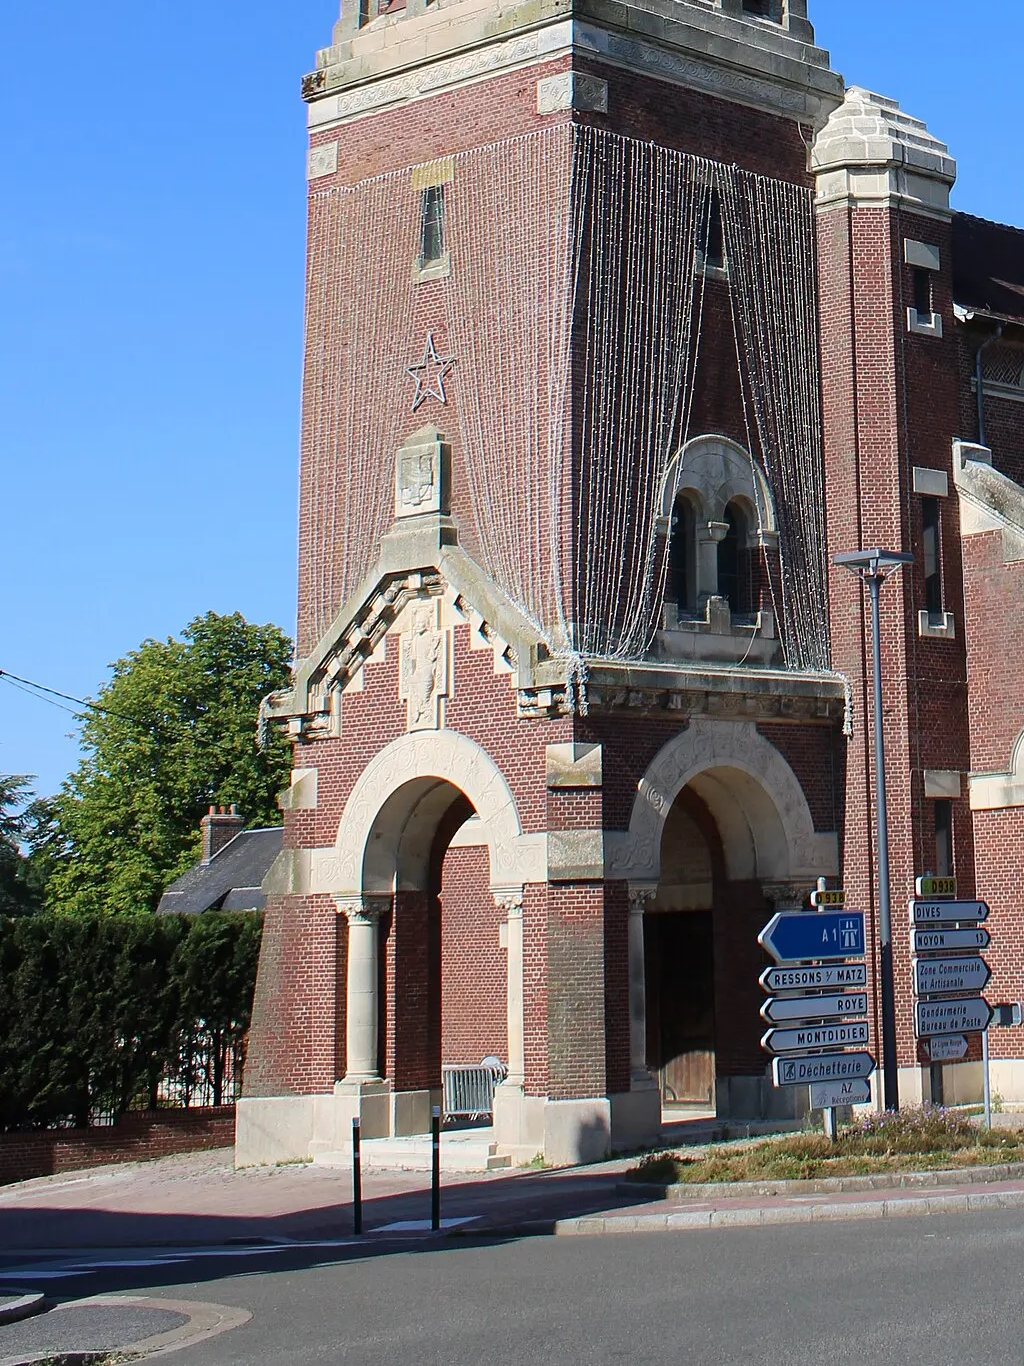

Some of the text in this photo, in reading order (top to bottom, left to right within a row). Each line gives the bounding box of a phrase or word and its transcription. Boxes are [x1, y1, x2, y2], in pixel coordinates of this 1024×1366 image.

[916, 905, 983, 919] DIVES 4
[917, 933, 984, 947] NOYON 13
[920, 961, 981, 976] Zone Commerciale
[774, 971, 822, 986] RESSONS
[837, 968, 863, 984] MATZ
[920, 977, 964, 990] et Artisanale
[837, 997, 864, 1011] ROYE
[920, 1003, 967, 1019] Gendarmerie
[921, 1016, 982, 1032] Bureau de Poste
[797, 1026, 865, 1045] MONTDIDIER
[799, 1059, 861, 1078] Déchetterie
[840, 1082, 853, 1094] AZ
[831, 1093, 865, 1105] Réceptions
